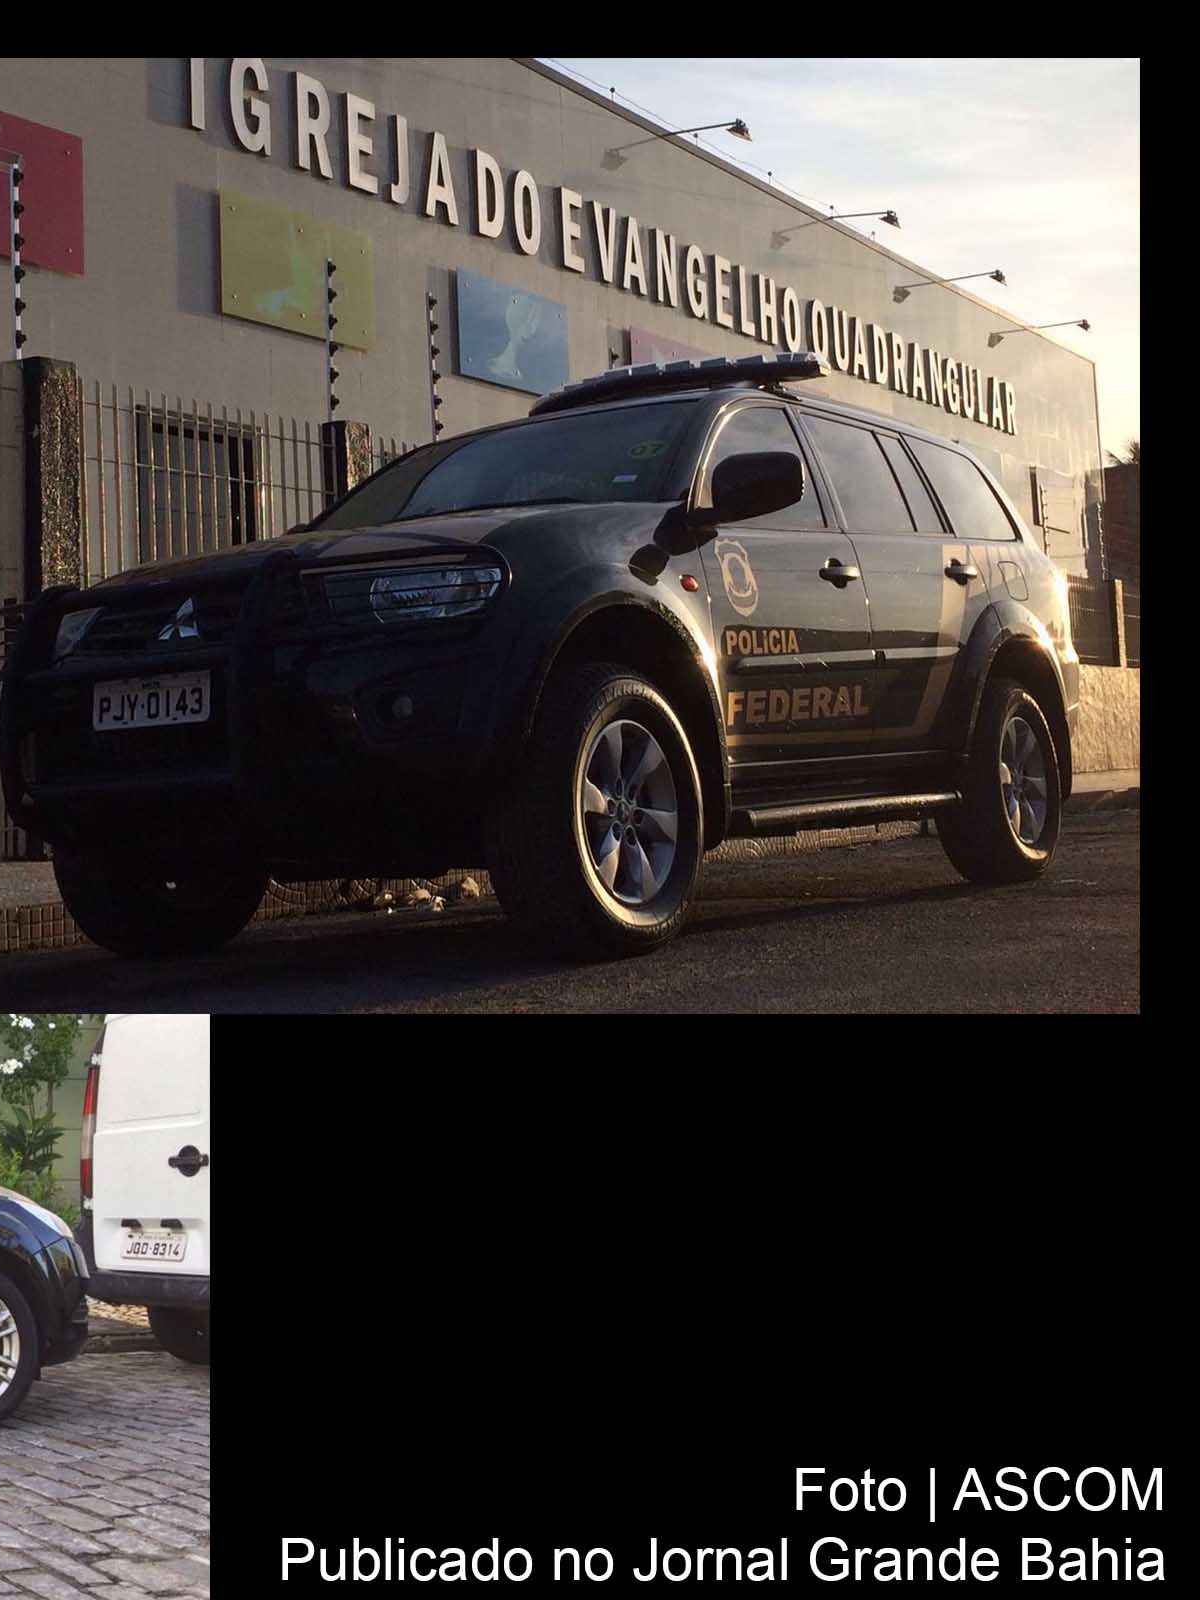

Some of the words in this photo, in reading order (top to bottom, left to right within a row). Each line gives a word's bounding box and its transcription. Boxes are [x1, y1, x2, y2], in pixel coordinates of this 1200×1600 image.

[190, 58, 458, 226] IGREJA
[476, 147, 541, 256] DO
[559, 186, 801, 354] EVANGELHO
[811, 299, 1018, 437] QUADRANGULAR
[726, 685, 870, 726] FEDERAL
